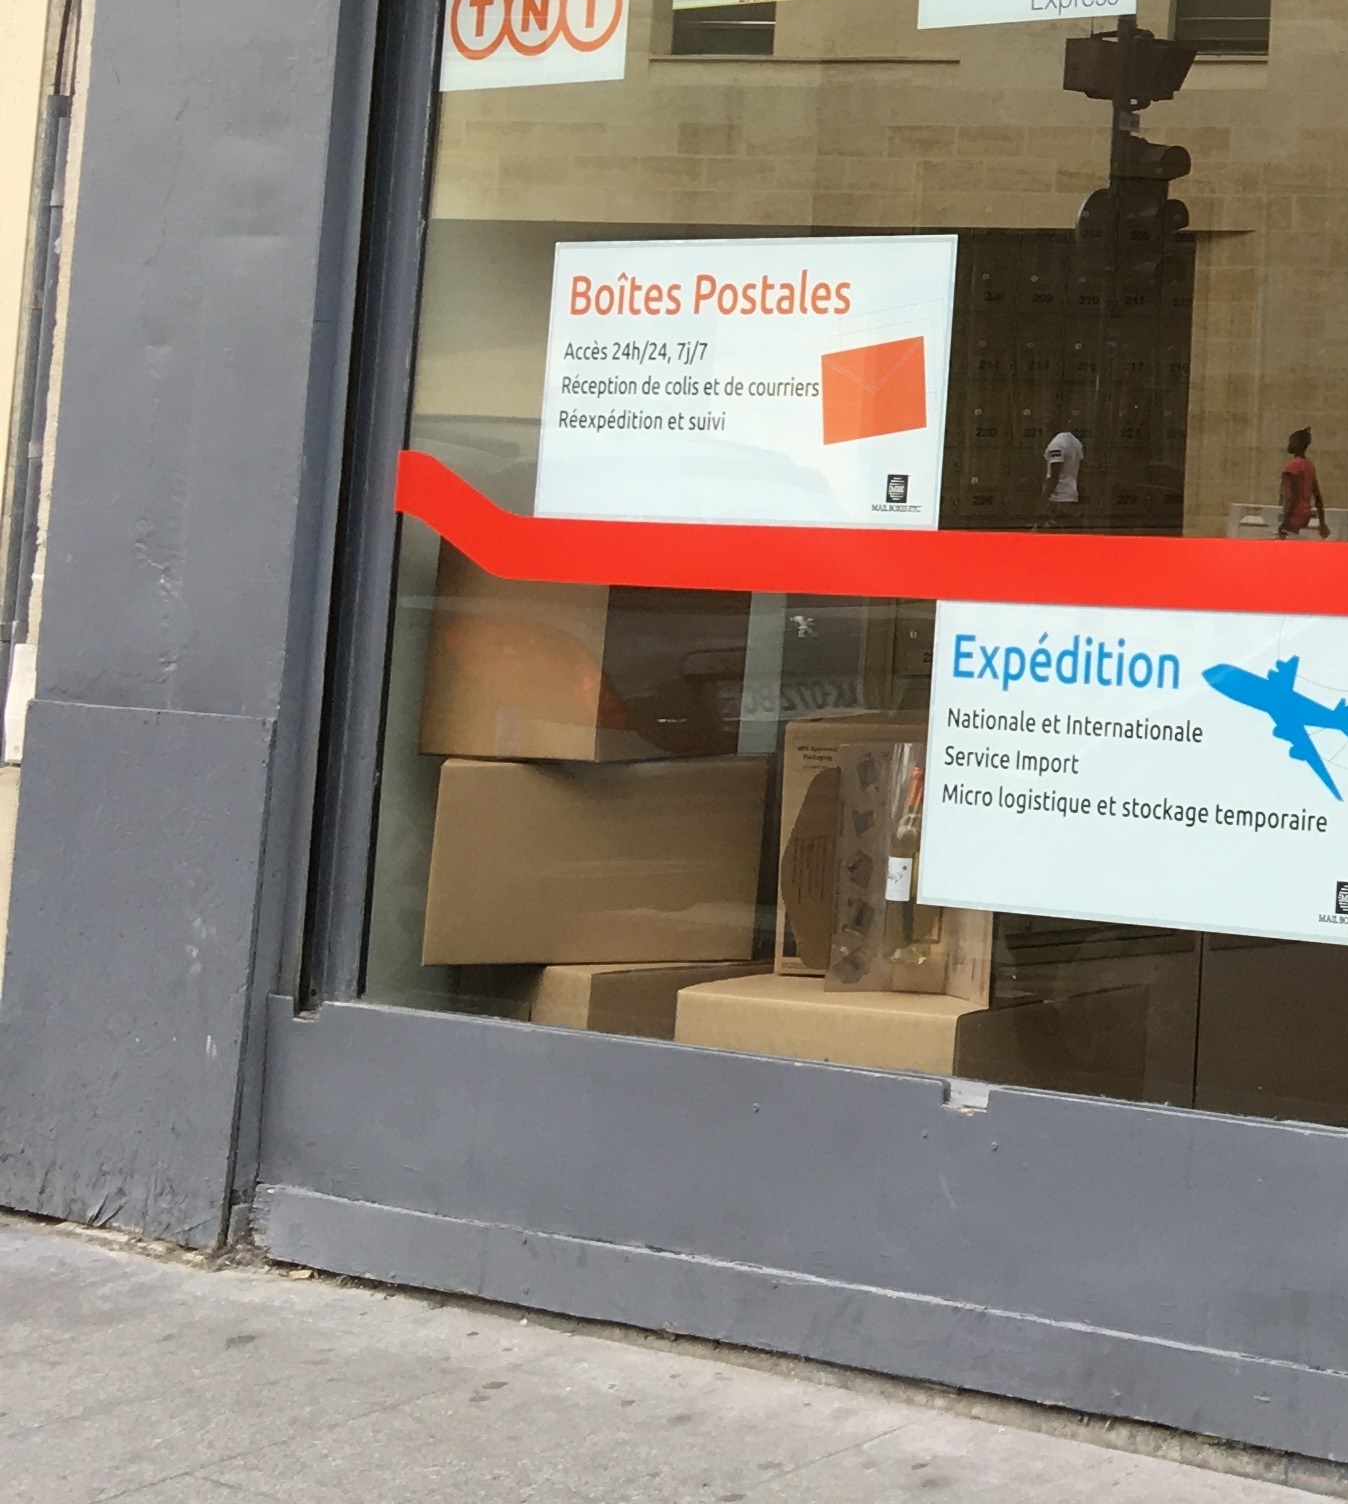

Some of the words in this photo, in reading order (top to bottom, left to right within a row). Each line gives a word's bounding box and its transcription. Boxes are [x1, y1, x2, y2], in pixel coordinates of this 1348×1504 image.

[569, 271, 682, 316] Boîtes
[693, 269, 851, 315] Postales
[563, 341, 608, 361] Accès
[612, 342, 671, 364] 24h/24,
[676, 342, 708, 364] 7j/7
[561, 375, 637, 398] Réception
[643, 376, 661, 395] de
[665, 376, 699, 396] colis
[703, 379, 720, 396] et
[724, 377, 744, 396] de
[748, 379, 820, 397] courriers
[558, 409, 663, 433] Réexpédition
[668, 412, 684, 430] et
[689, 411, 726, 431] suivi
[953, 631, 1180, 692] Expédition
[947, 708, 1035, 734] Nationale
[1041, 714, 1061, 734] et
[1066, 714, 1203, 743] Internationale
[944, 745, 1010, 770] Service
[1016, 750, 1079, 776] Import
[942, 784, 993, 807] Micro
[998, 785, 1091, 818] logistique
[1097, 796, 1116, 816] et
[1122, 797, 1208, 828] stockage
[1215, 804, 1328, 833] temporaire
